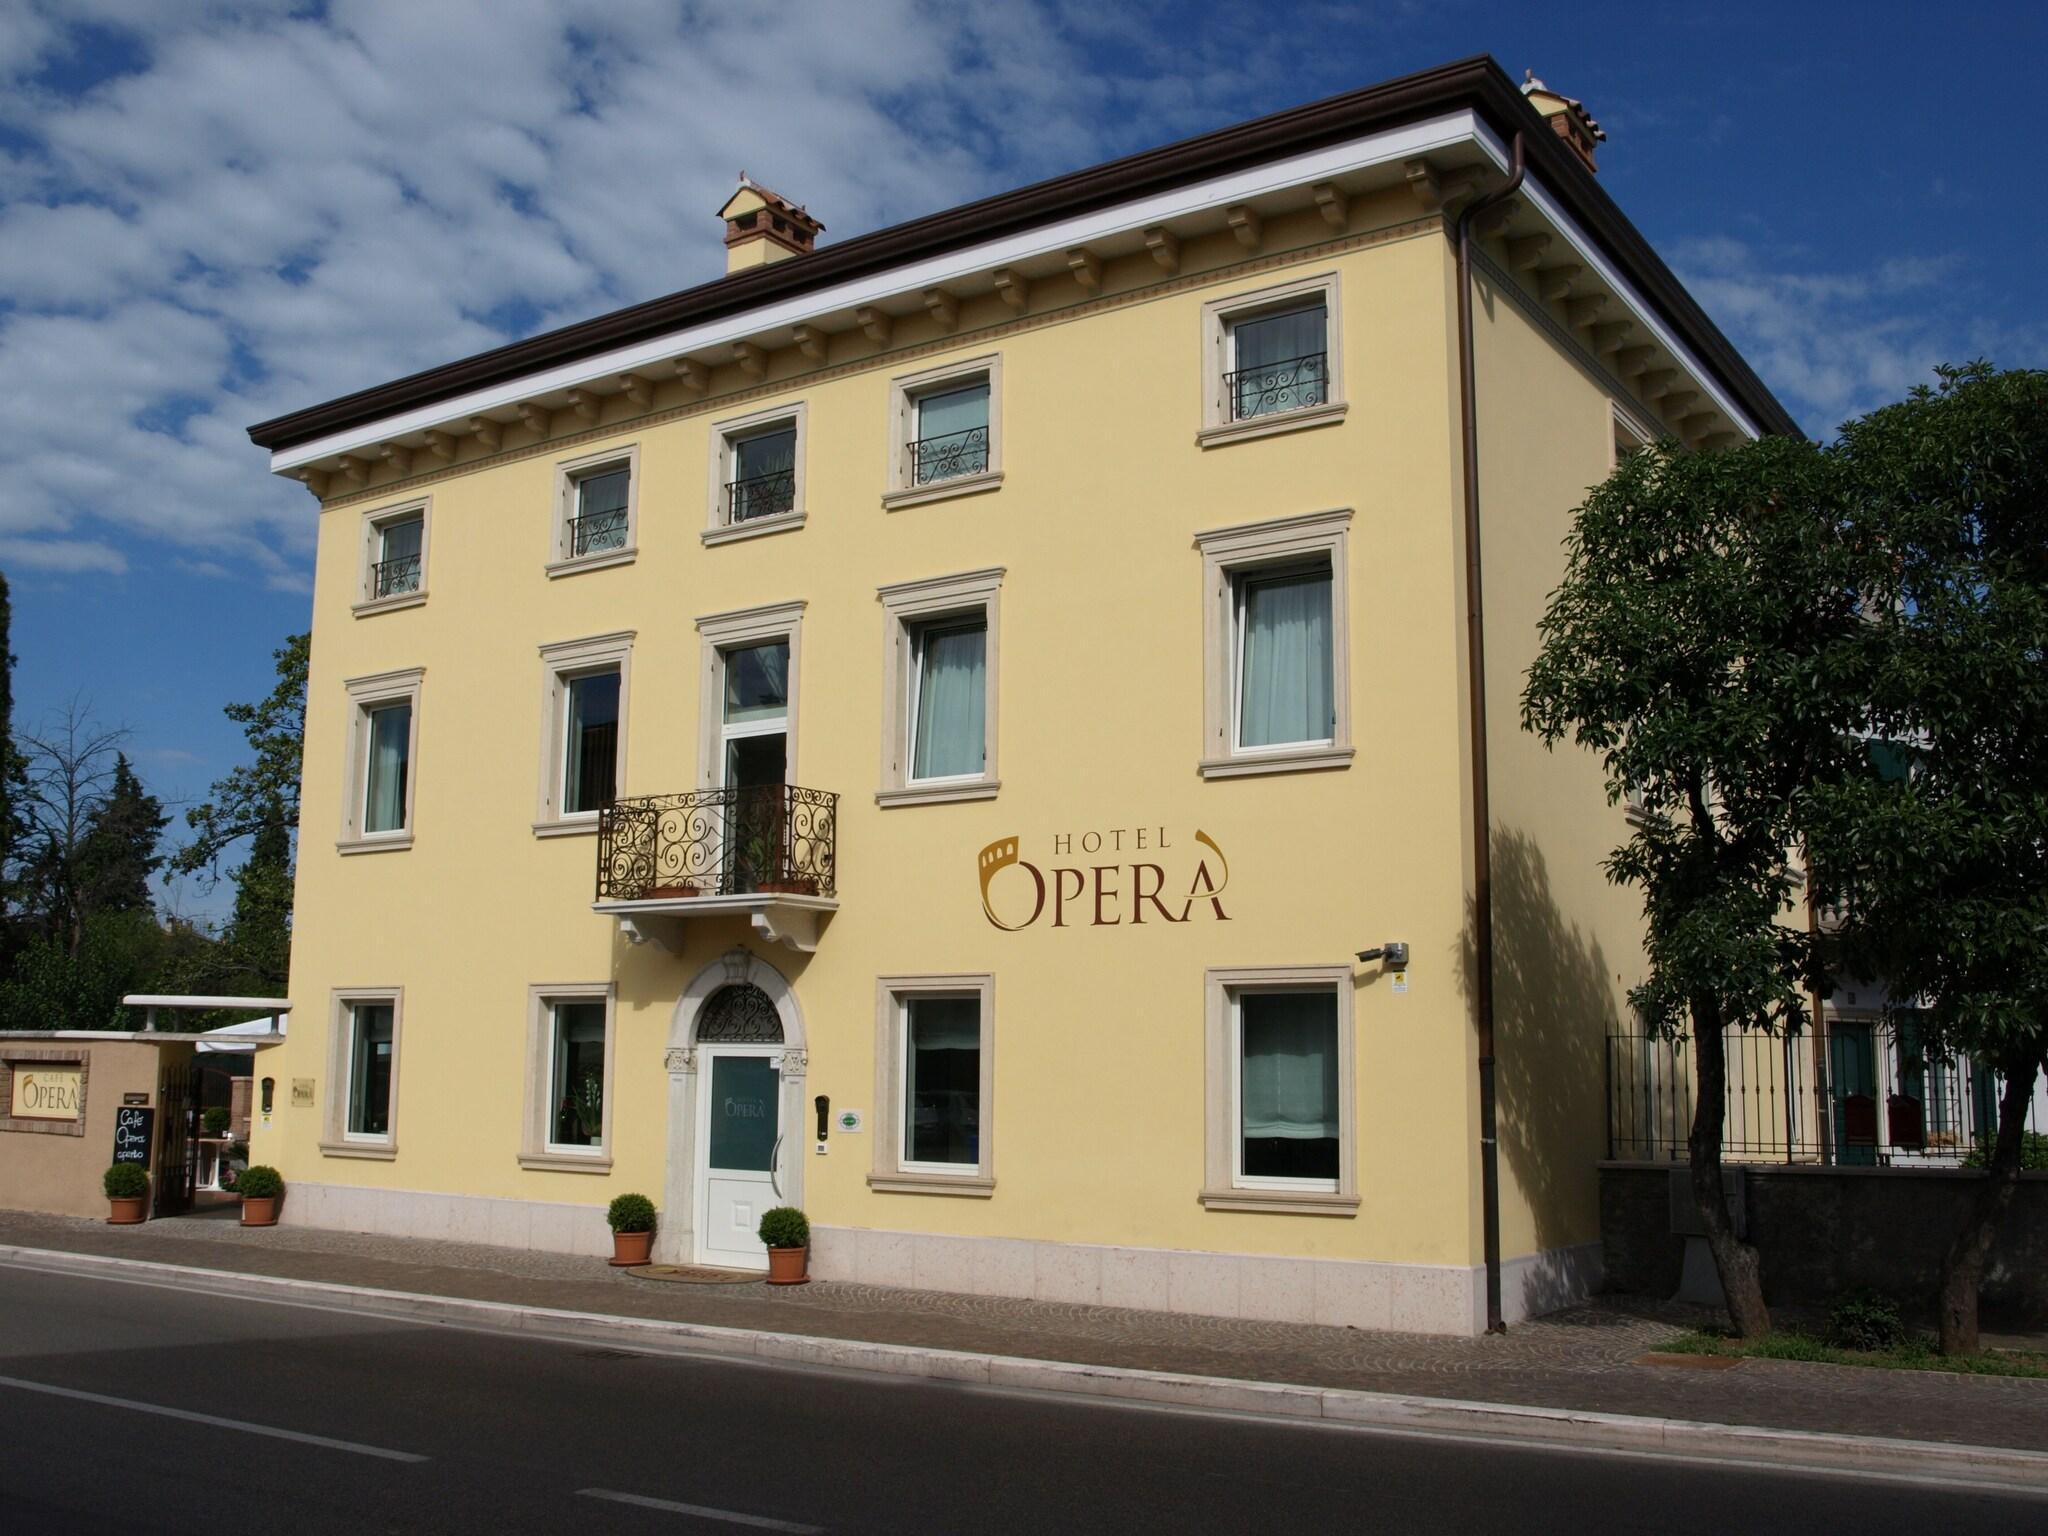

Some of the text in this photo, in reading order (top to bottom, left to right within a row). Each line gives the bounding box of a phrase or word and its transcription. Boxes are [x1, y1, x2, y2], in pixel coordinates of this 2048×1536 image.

[1054, 827, 1171, 855] HOTEL
[978, 829, 1232, 931] OPERA
[23, 1074, 79, 1110] OPERA
